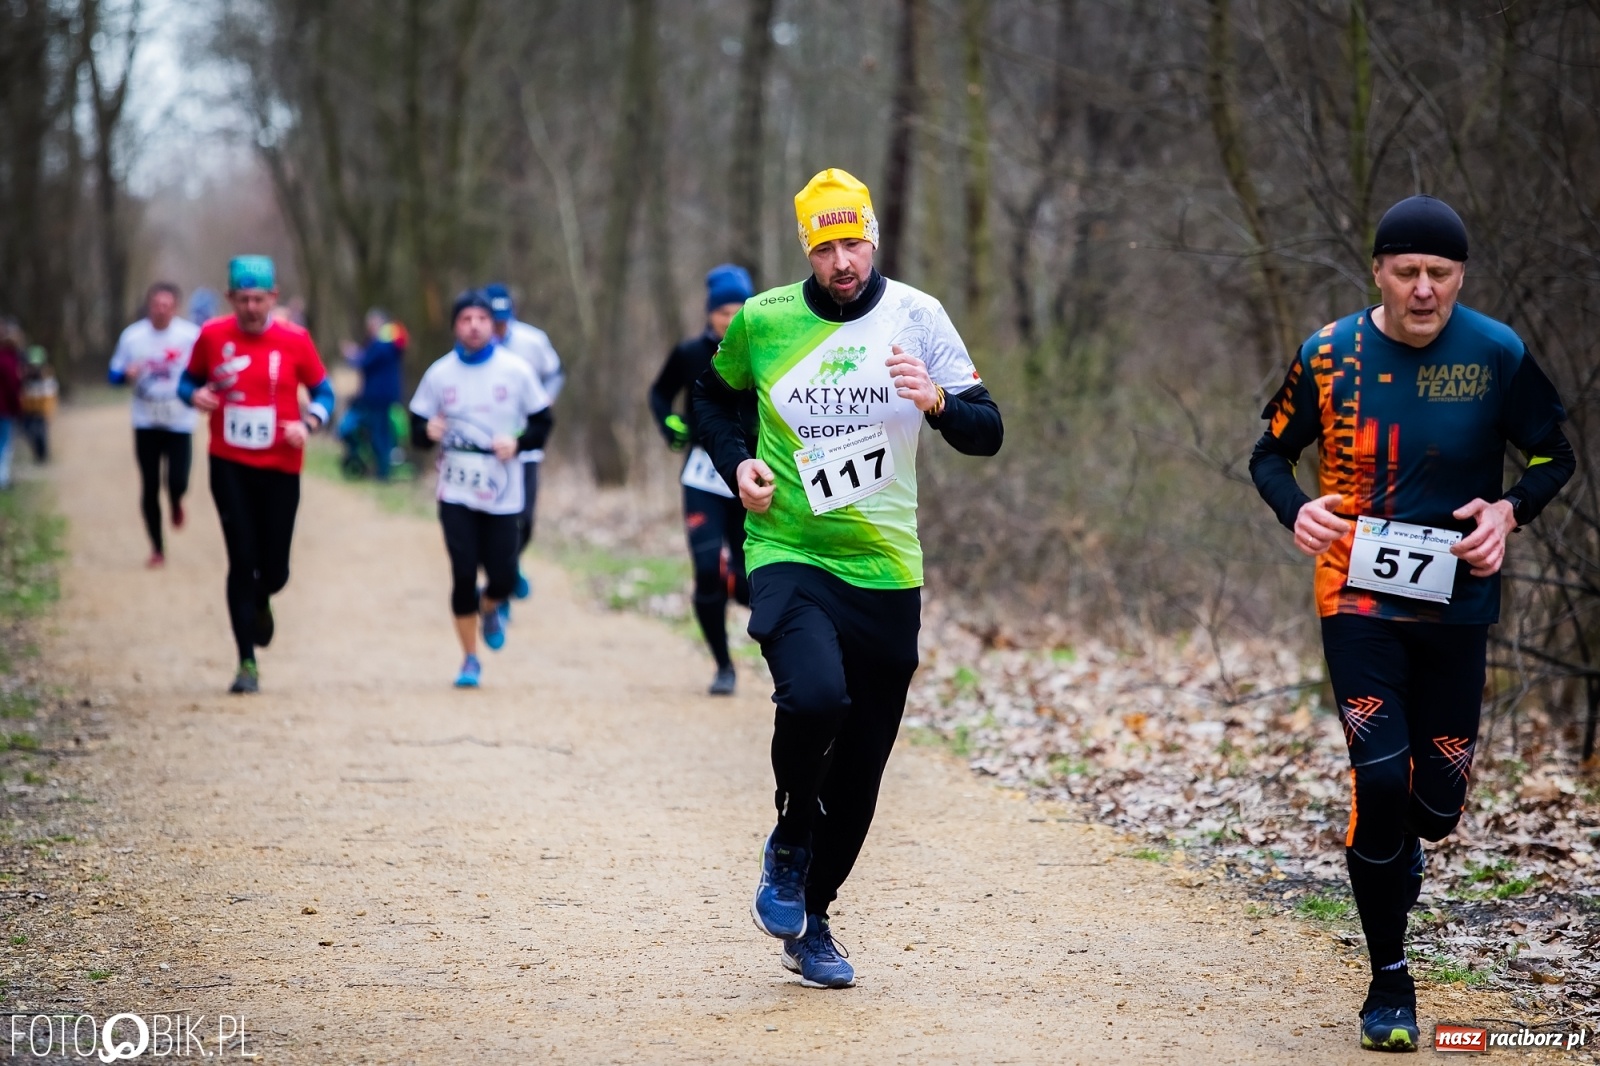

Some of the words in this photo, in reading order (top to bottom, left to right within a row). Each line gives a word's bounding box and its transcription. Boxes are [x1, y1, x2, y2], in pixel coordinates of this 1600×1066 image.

[818, 211, 858, 228] MARATON
[759, 295, 795, 307] deep
[1417, 363, 1481, 381] MARO
[788, 387, 889, 404] AKTYWNI
[1416, 380, 1478, 397] TEAM
[810, 404, 869, 415] LYSKI
[811, 447, 886, 498] 117
[1372, 547, 1435, 584] 57
